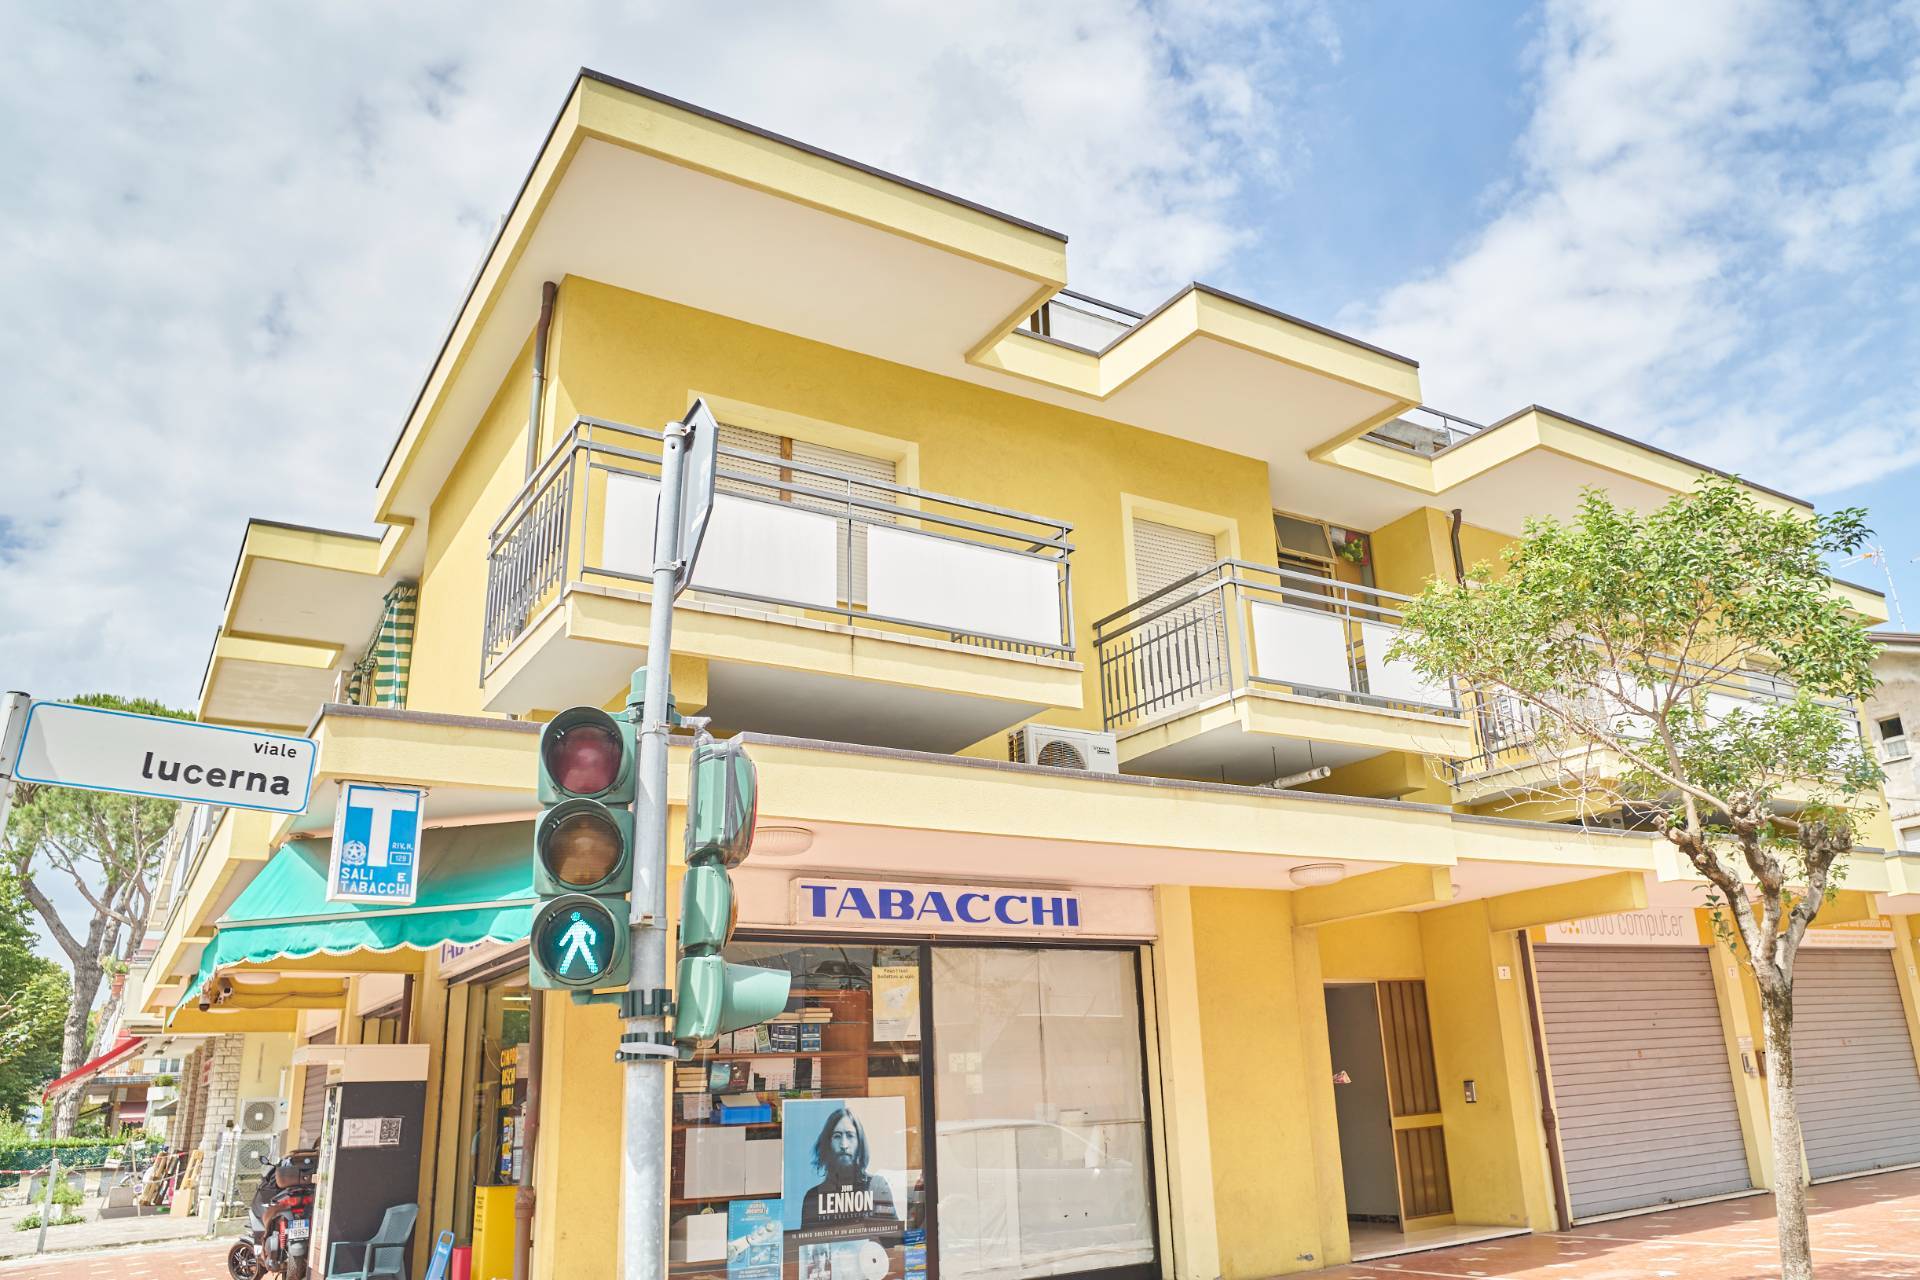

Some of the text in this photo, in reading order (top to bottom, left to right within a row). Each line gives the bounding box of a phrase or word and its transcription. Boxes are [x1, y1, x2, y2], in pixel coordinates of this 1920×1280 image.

[254, 742, 296, 758] viale
[142, 752, 290, 796] lucerna
[349, 788, 418, 867] T
[340, 868, 406, 882] SALI E
[340, 880, 409, 894] TABACCHI
[801, 885, 1079, 926] TABACCHI
[1618, 910, 1684, 941] computer
[818, 1190, 873, 1214] LENNON
